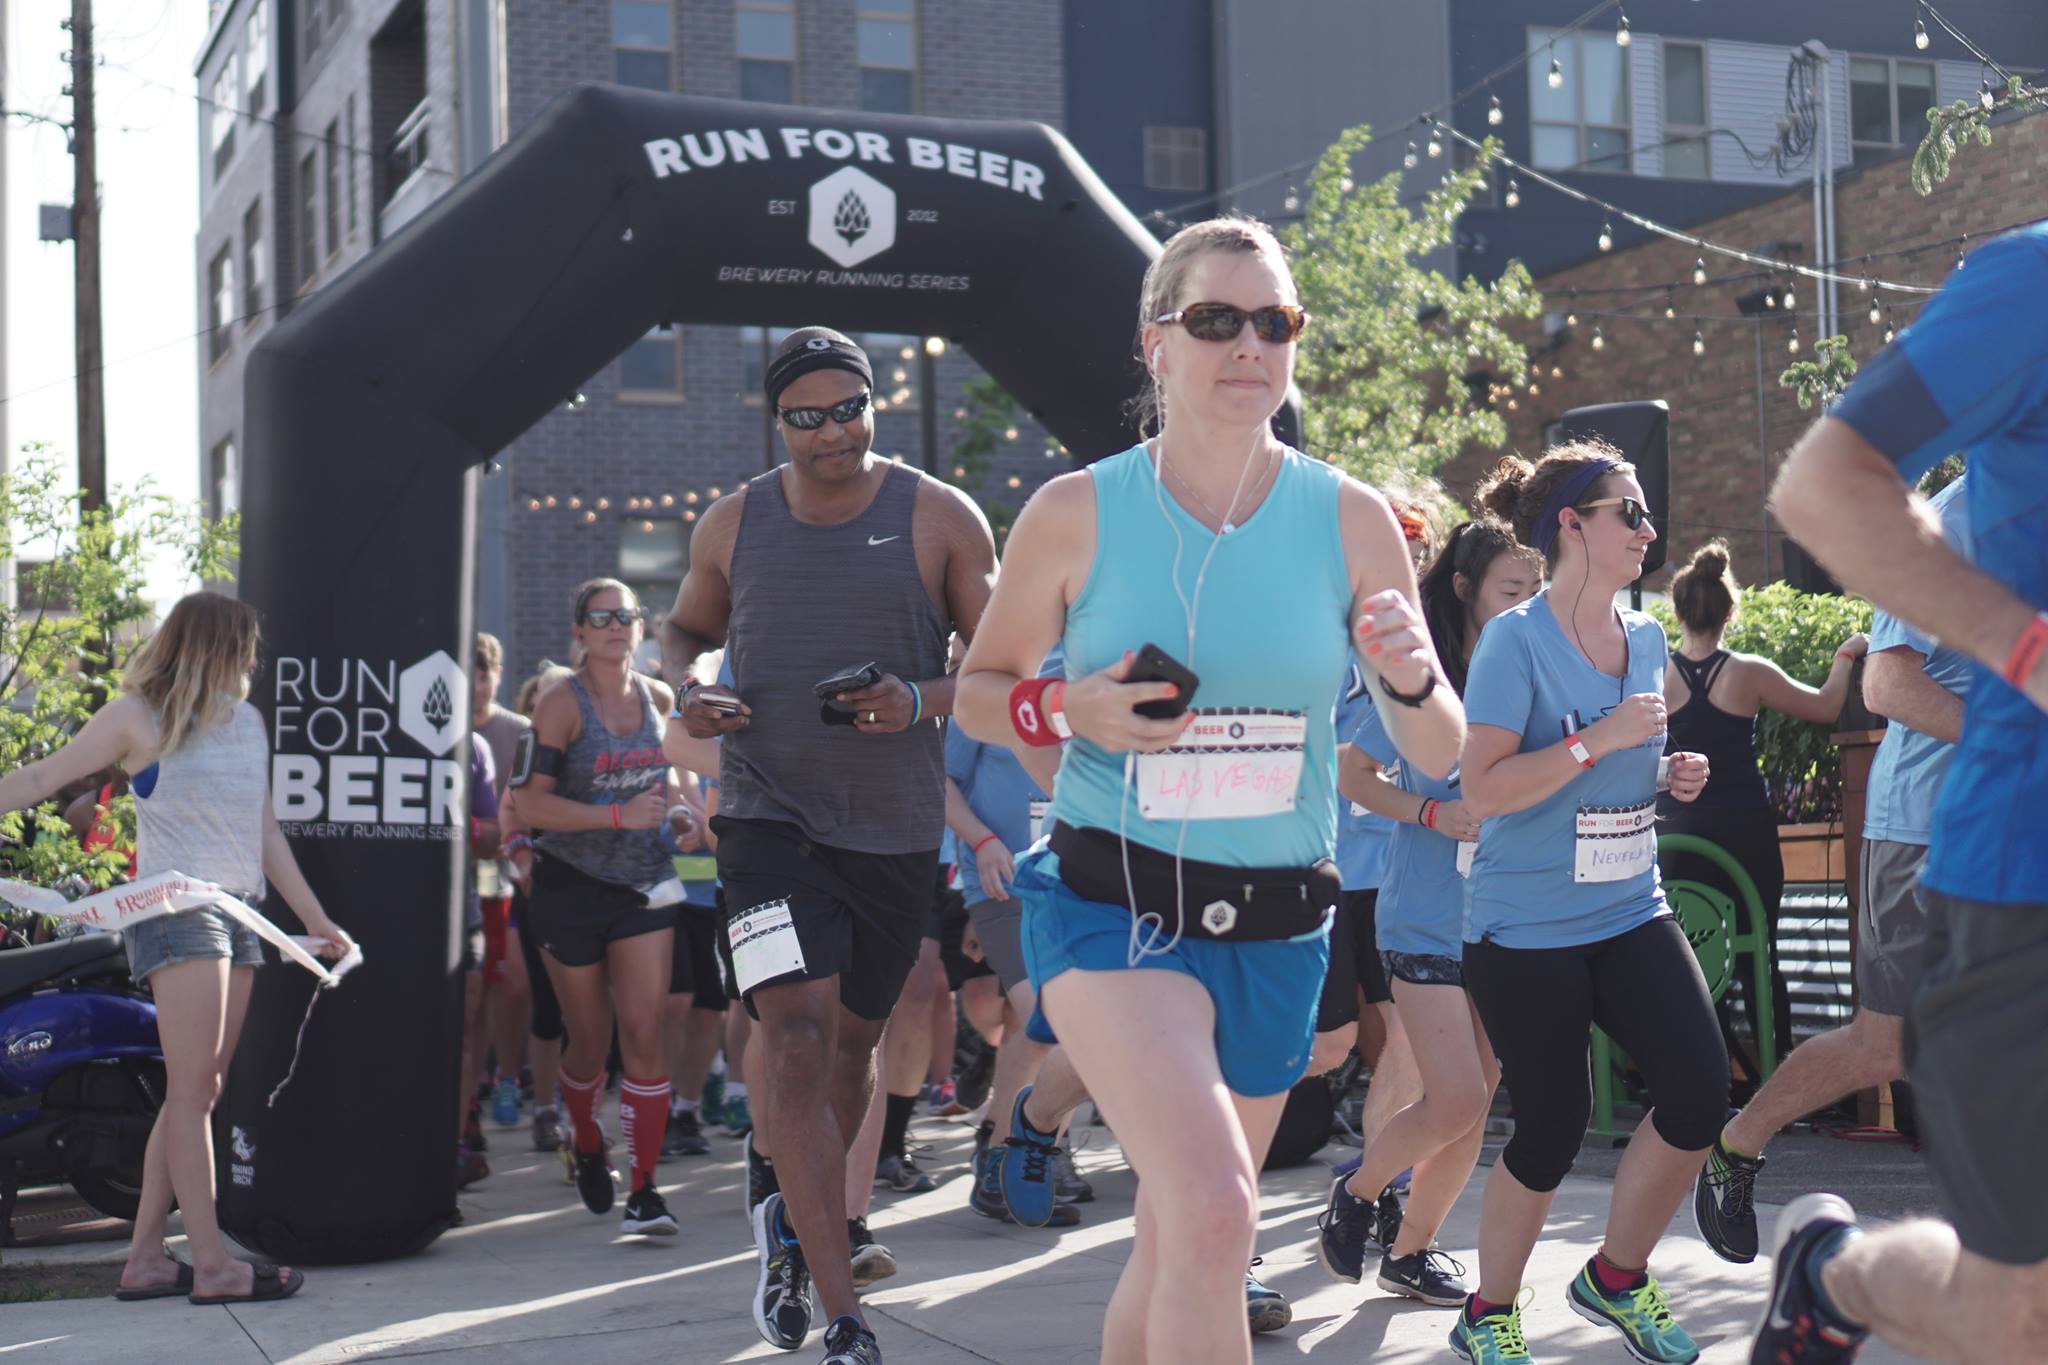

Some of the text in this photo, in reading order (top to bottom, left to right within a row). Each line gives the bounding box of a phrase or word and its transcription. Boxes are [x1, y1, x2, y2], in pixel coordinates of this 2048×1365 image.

[643, 127, 1046, 201] RUN FOR BEER
[767, 200, 797, 216] EST
[906, 208, 939, 223] 2012
[718, 265, 970, 291] BREWERY RUNNING SERIES
[276, 656, 396, 705] RUN
[275, 706, 391, 754] FOR
[1193, 724, 1225, 736] BEER
[271, 753, 466, 825] BEER
[1158, 762, 1297, 799] LAS VEGAS
[352, 823, 426, 840] RUNNING
[1578, 818, 1597, 827] RUN
[1615, 818, 1633, 827] BEER
